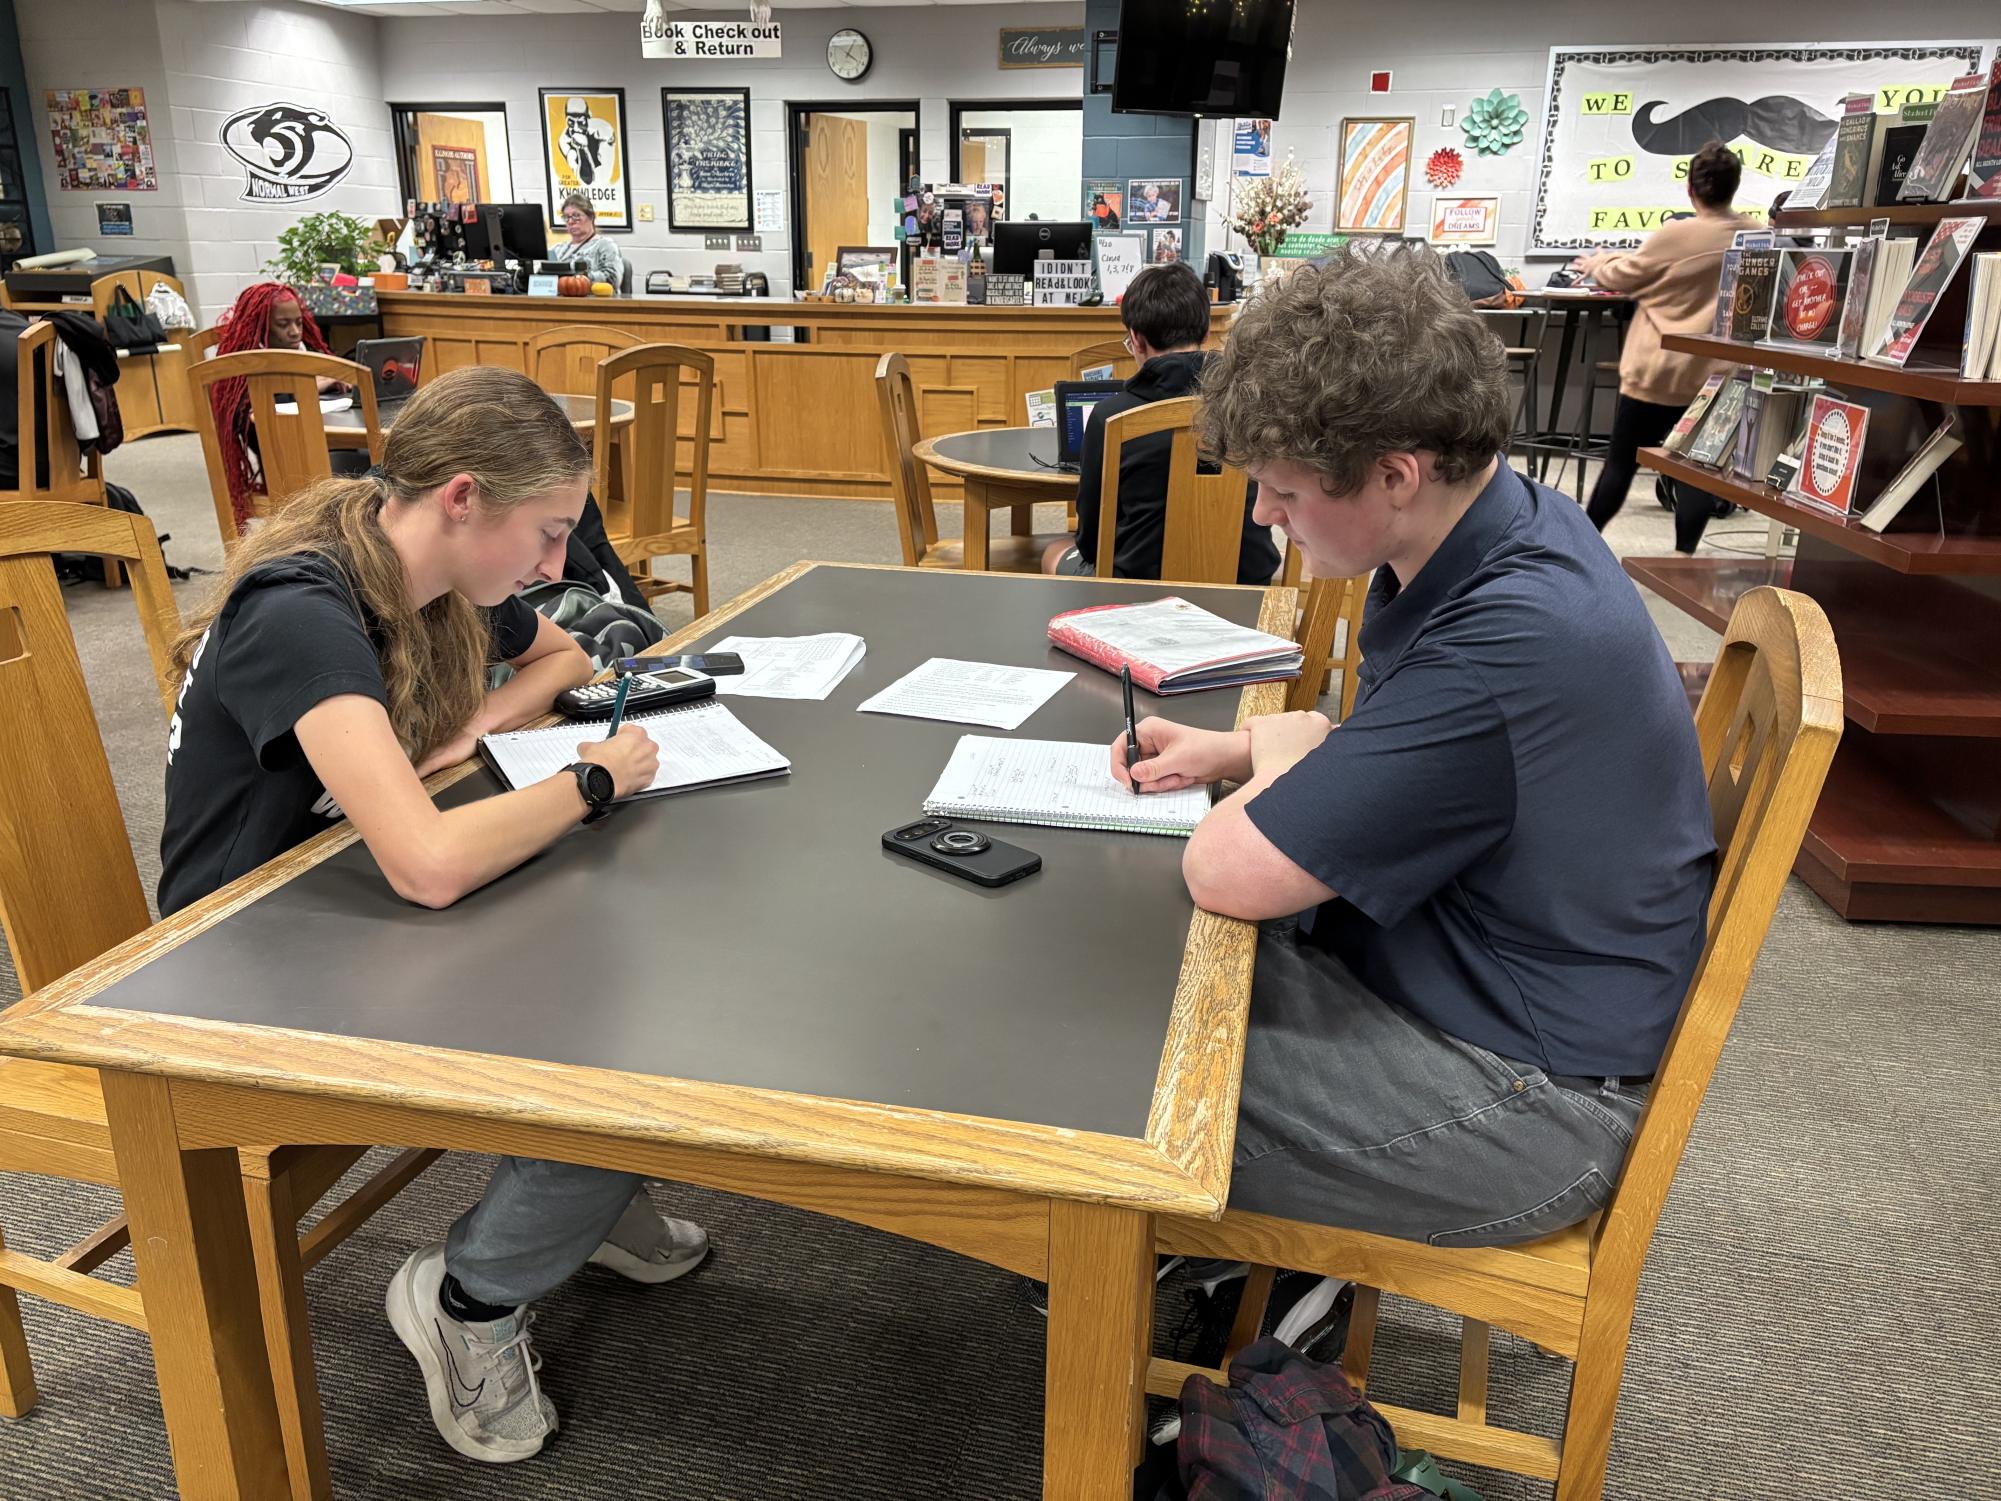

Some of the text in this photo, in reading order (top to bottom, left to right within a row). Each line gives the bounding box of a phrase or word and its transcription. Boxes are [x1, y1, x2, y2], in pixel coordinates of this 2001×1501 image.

[643, 24, 780, 39] Book Check out
[674, 41, 754, 55] & Return
[1008, 36, 1062, 60] Always
[1585, 94, 1629, 112] WE
[1590, 159, 1631, 180] TO
[1674, 148, 1801, 179] SARE
[251, 177, 310, 198] NORMAL WEST
[1449, 208, 1482, 216] FOLLOW
[1738, 267, 1770, 276] GAMES
[1042, 294, 1053, 304] AT
